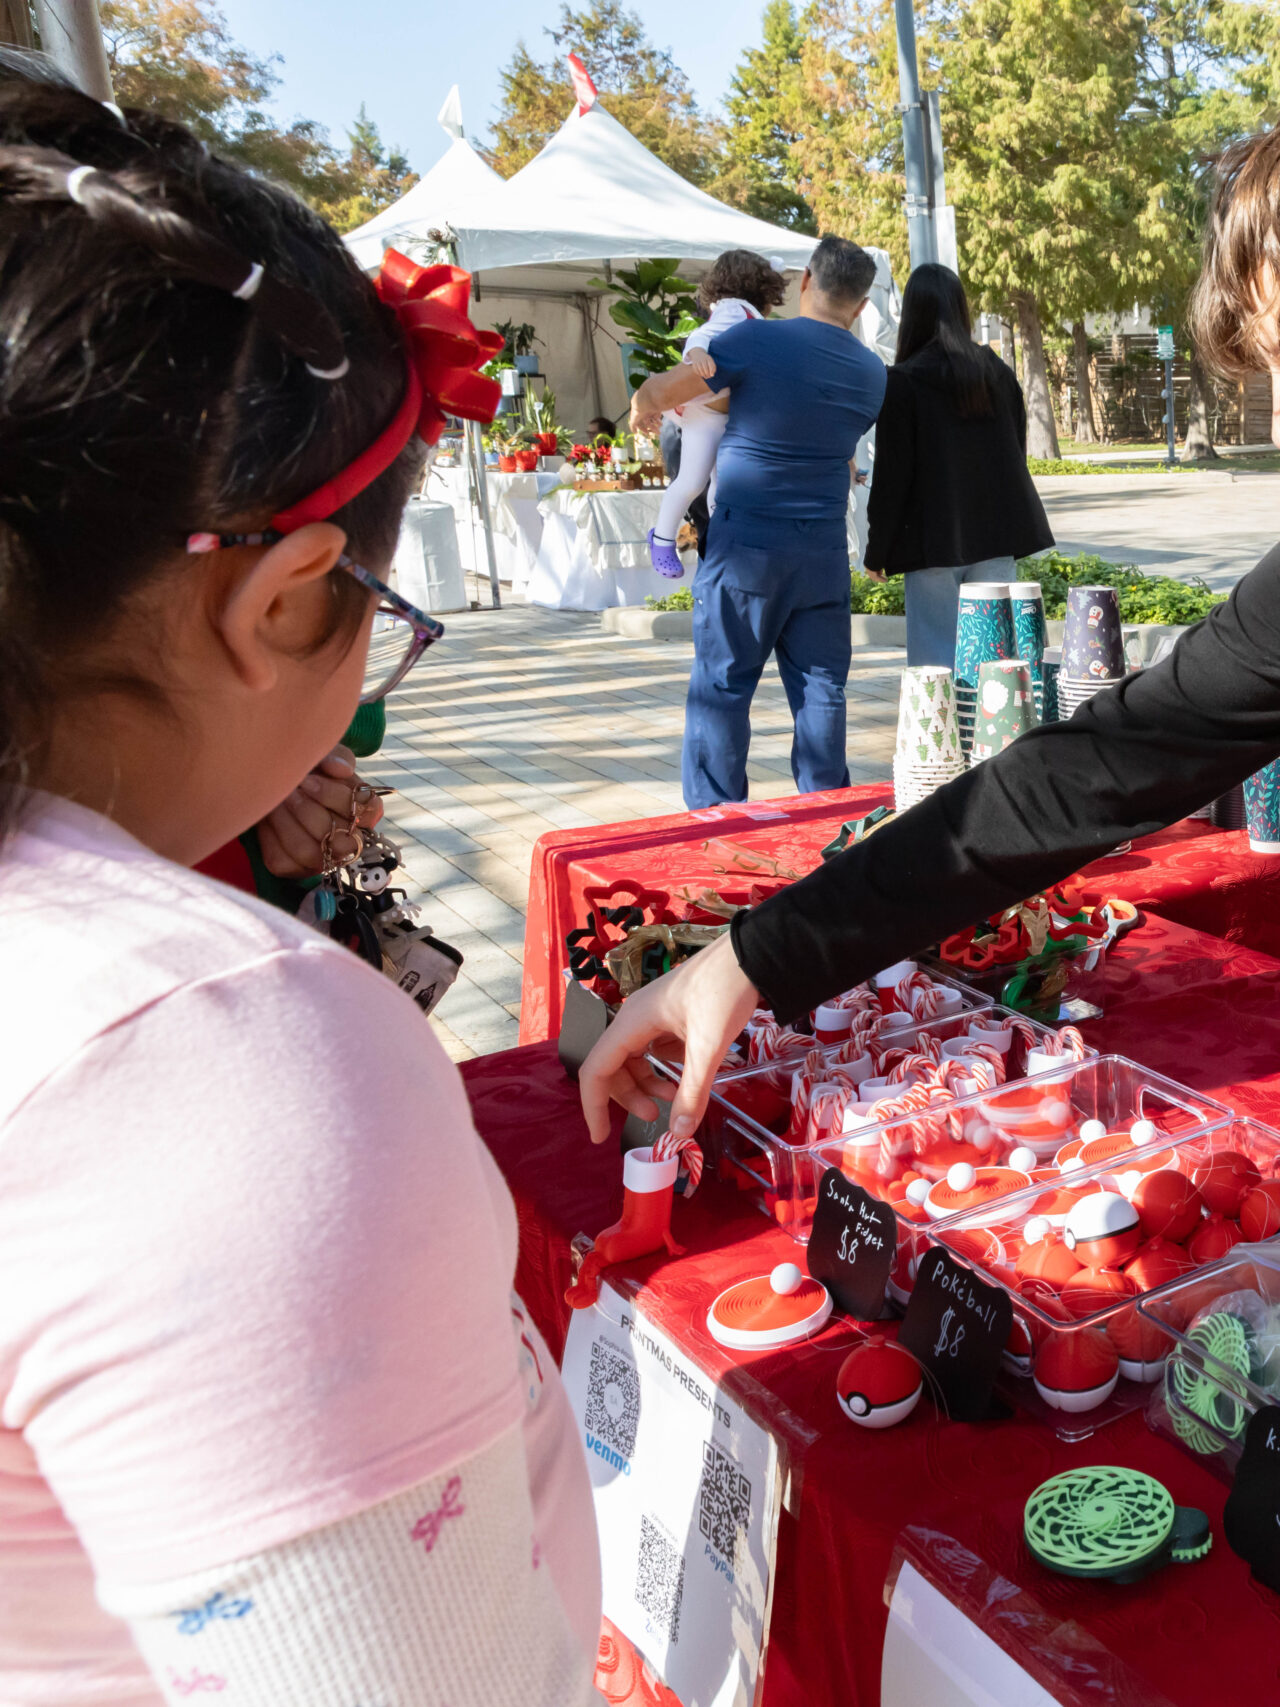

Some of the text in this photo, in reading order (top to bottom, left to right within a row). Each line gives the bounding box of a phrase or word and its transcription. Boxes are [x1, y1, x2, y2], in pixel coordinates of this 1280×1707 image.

[826, 1178, 854, 1213] Santa
[836, 1224, 859, 1264] $8
[855, 1222, 884, 1251] Fidget
[932, 1260, 997, 1333] Pokéball
[933, 1305, 966, 1358] $8
[621, 1314, 731, 1429] PRINTMAS PRESENTS
[586, 1432, 631, 1477] venmo
[704, 1543, 735, 1585] PayPal
